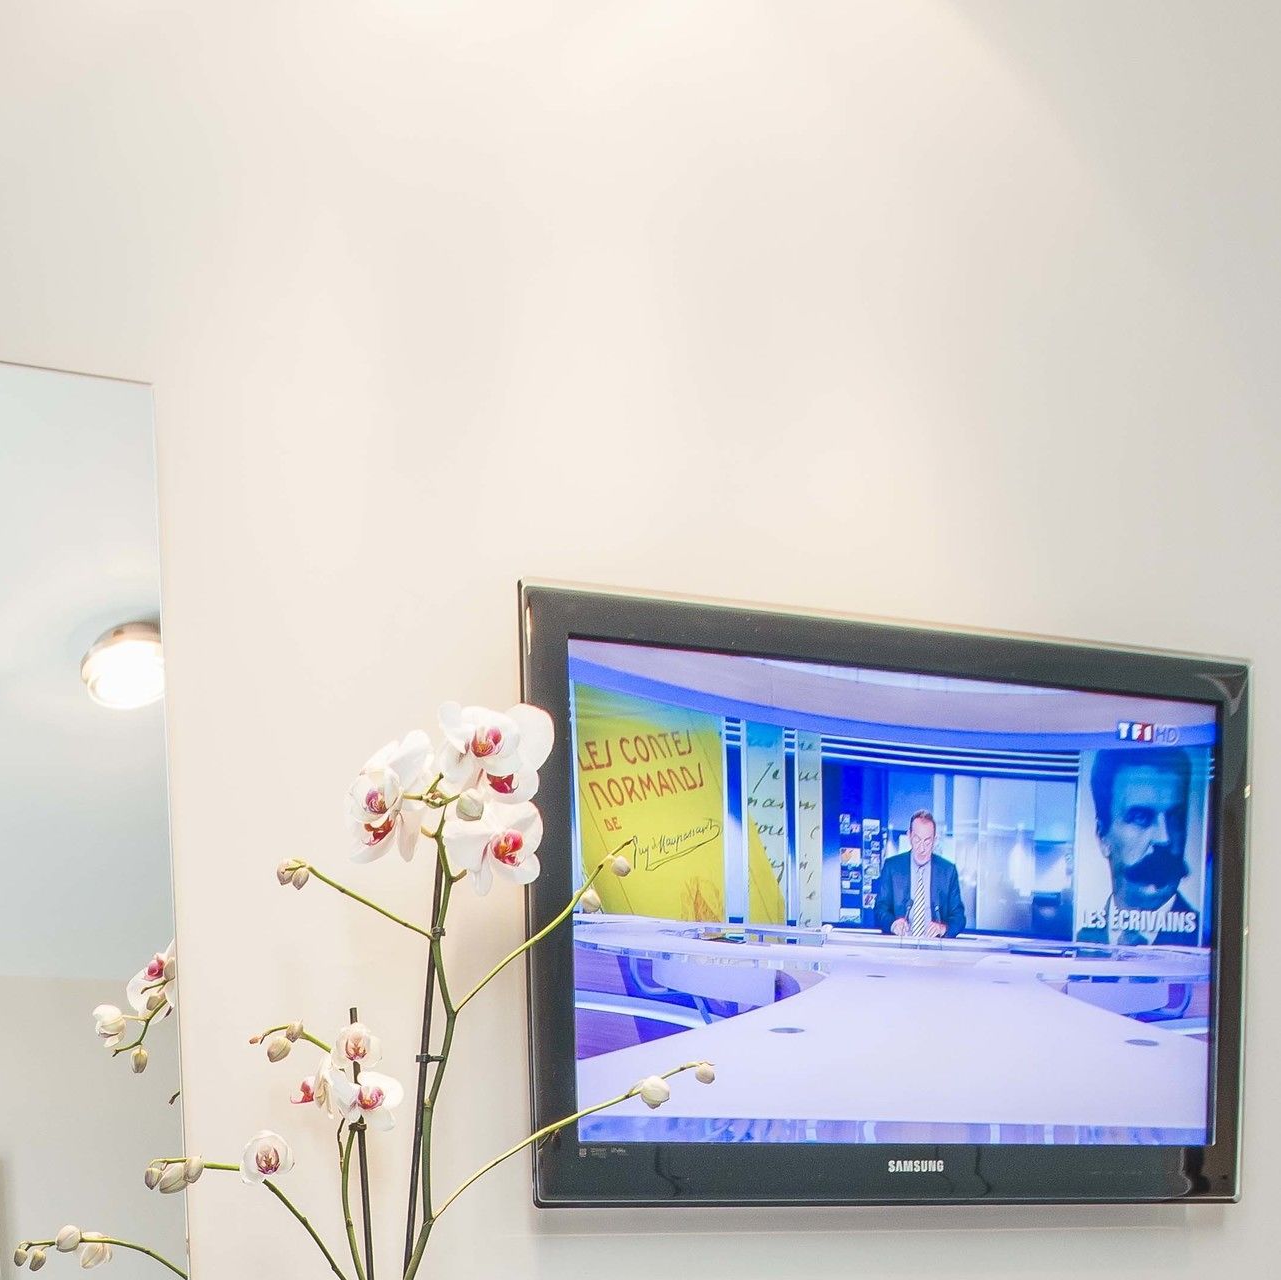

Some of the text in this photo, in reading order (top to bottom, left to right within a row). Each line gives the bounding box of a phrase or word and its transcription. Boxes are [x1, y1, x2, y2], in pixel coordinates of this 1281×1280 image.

[1119, 722, 1152, 742] TF1
[577, 730, 693, 771] LES CONTES
[589, 763, 704, 810] NORMANDS
[604, 816, 622, 832] DE
[1082, 908, 1107, 929] LES
[887, 1160, 944, 1173] SAMSUNG
